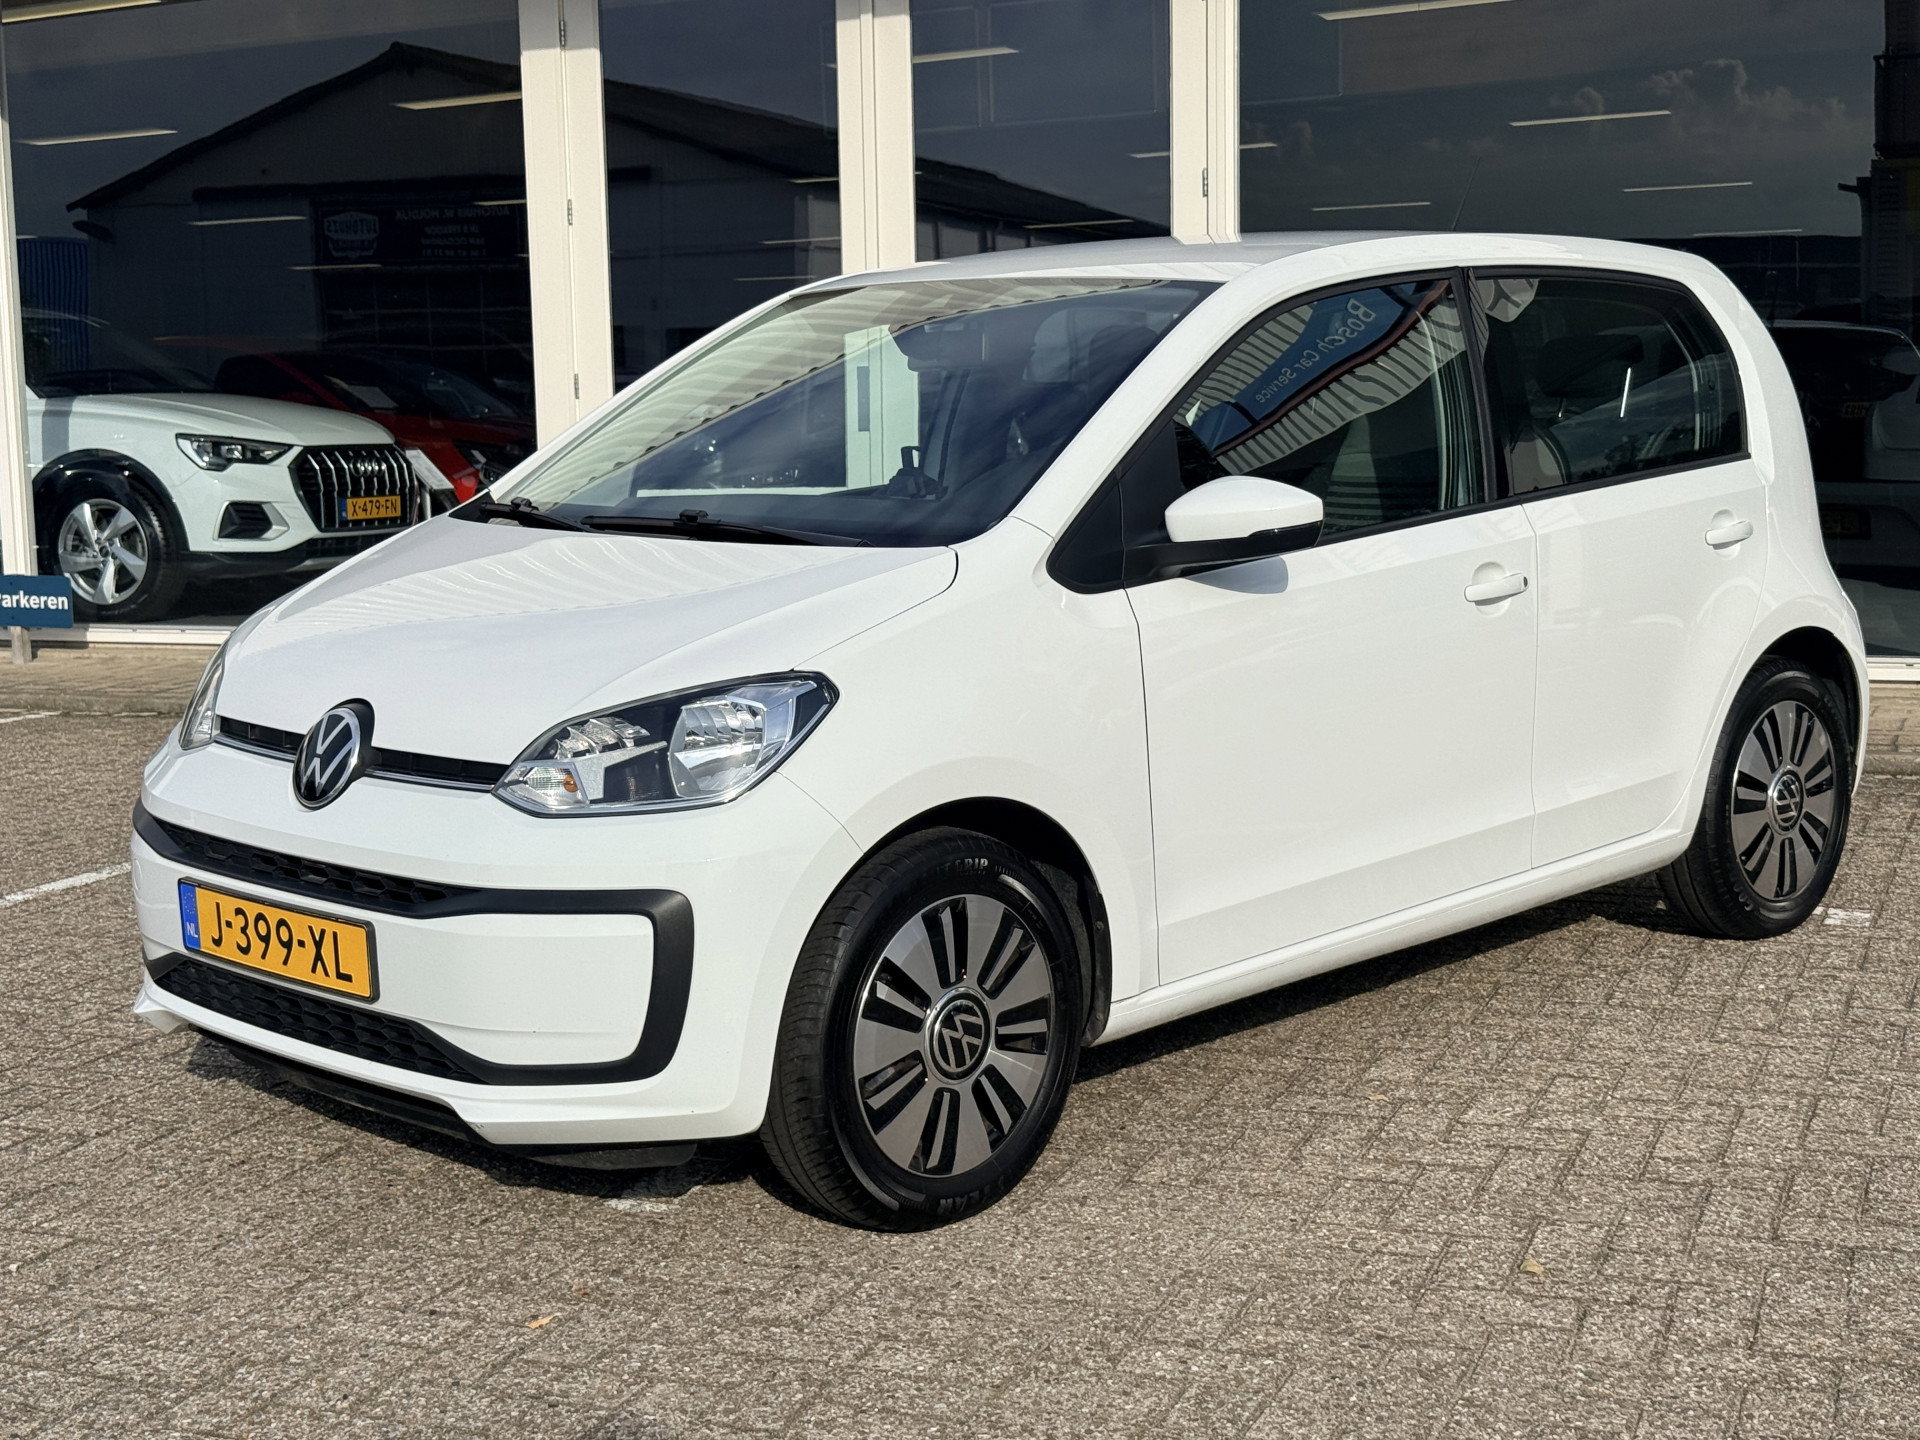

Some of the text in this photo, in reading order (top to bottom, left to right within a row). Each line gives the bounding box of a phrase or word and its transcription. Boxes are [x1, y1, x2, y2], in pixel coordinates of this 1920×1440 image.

[351, 498, 397, 517] X-479-FN
[0, 589, 69, 610] arkeren
[186, 901, 353, 983] NL J-399-XL
